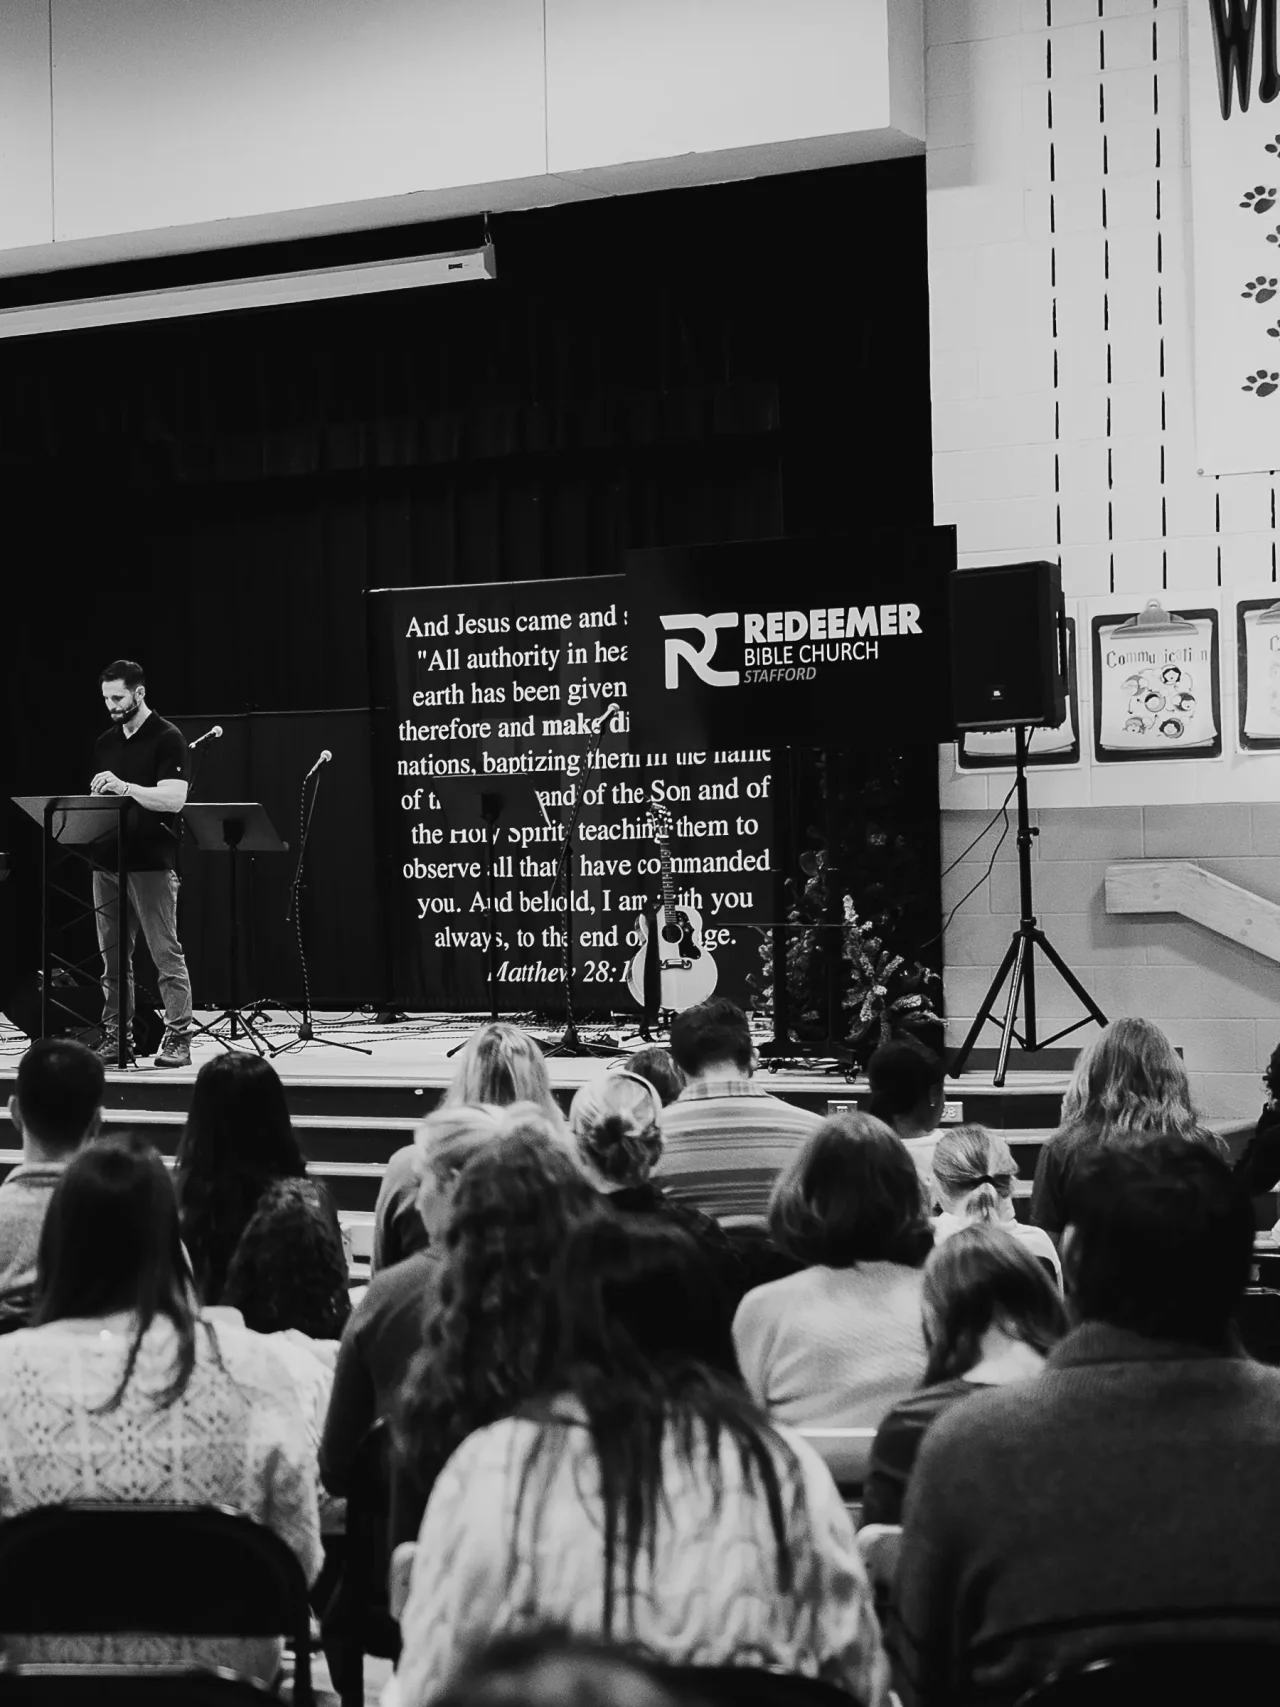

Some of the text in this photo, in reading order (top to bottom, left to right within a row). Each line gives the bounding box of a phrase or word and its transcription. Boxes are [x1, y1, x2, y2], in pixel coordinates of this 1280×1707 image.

[405, 614, 450, 638] And
[455, 613, 511, 636] Jesus
[515, 612, 572, 632] came
[578, 604, 617, 629] and
[744, 603, 923, 644] REDEEMER
[417, 648, 461, 671] "All
[466, 644, 560, 672] authority
[567, 642, 588, 665] in
[744, 641, 879, 666] BIBLE CHURCH
[1106, 647, 1208, 669] Communicatin
[743, 667, 817, 684] STAFFORD
[412, 676, 628, 707] earth has been given
[398, 717, 491, 742] therefore
[497, 715, 535, 738] and
[541, 712, 601, 736] make
[397, 753, 477, 776] nations,
[482, 749, 581, 777] baptizing
[587, 747, 641, 770] them
[401, 788, 424, 810] of
[538, 784, 577, 807] and
[583, 782, 608, 806] of
[612, 782, 645, 804] the
[650, 779, 692, 803] Son
[698, 776, 739, 801] and
[746, 775, 772, 799] of
[411, 823, 444, 845] the
[676, 815, 729, 838] them
[736, 816, 759, 836] to
[402, 857, 482, 880] observe
[519, 855, 558, 878] that
[580, 854, 632, 877] have
[417, 897, 462, 920] you.
[519, 889, 596, 916] behold,
[602, 889, 612, 912] I
[657, 886, 703, 910] ith
[711, 892, 754, 915] you
[434, 926, 510, 953] always,
[517, 928, 535, 947] to
[541, 925, 568, 948] the
[579, 925, 618, 947] end
[700, 927, 737, 952] ge.
